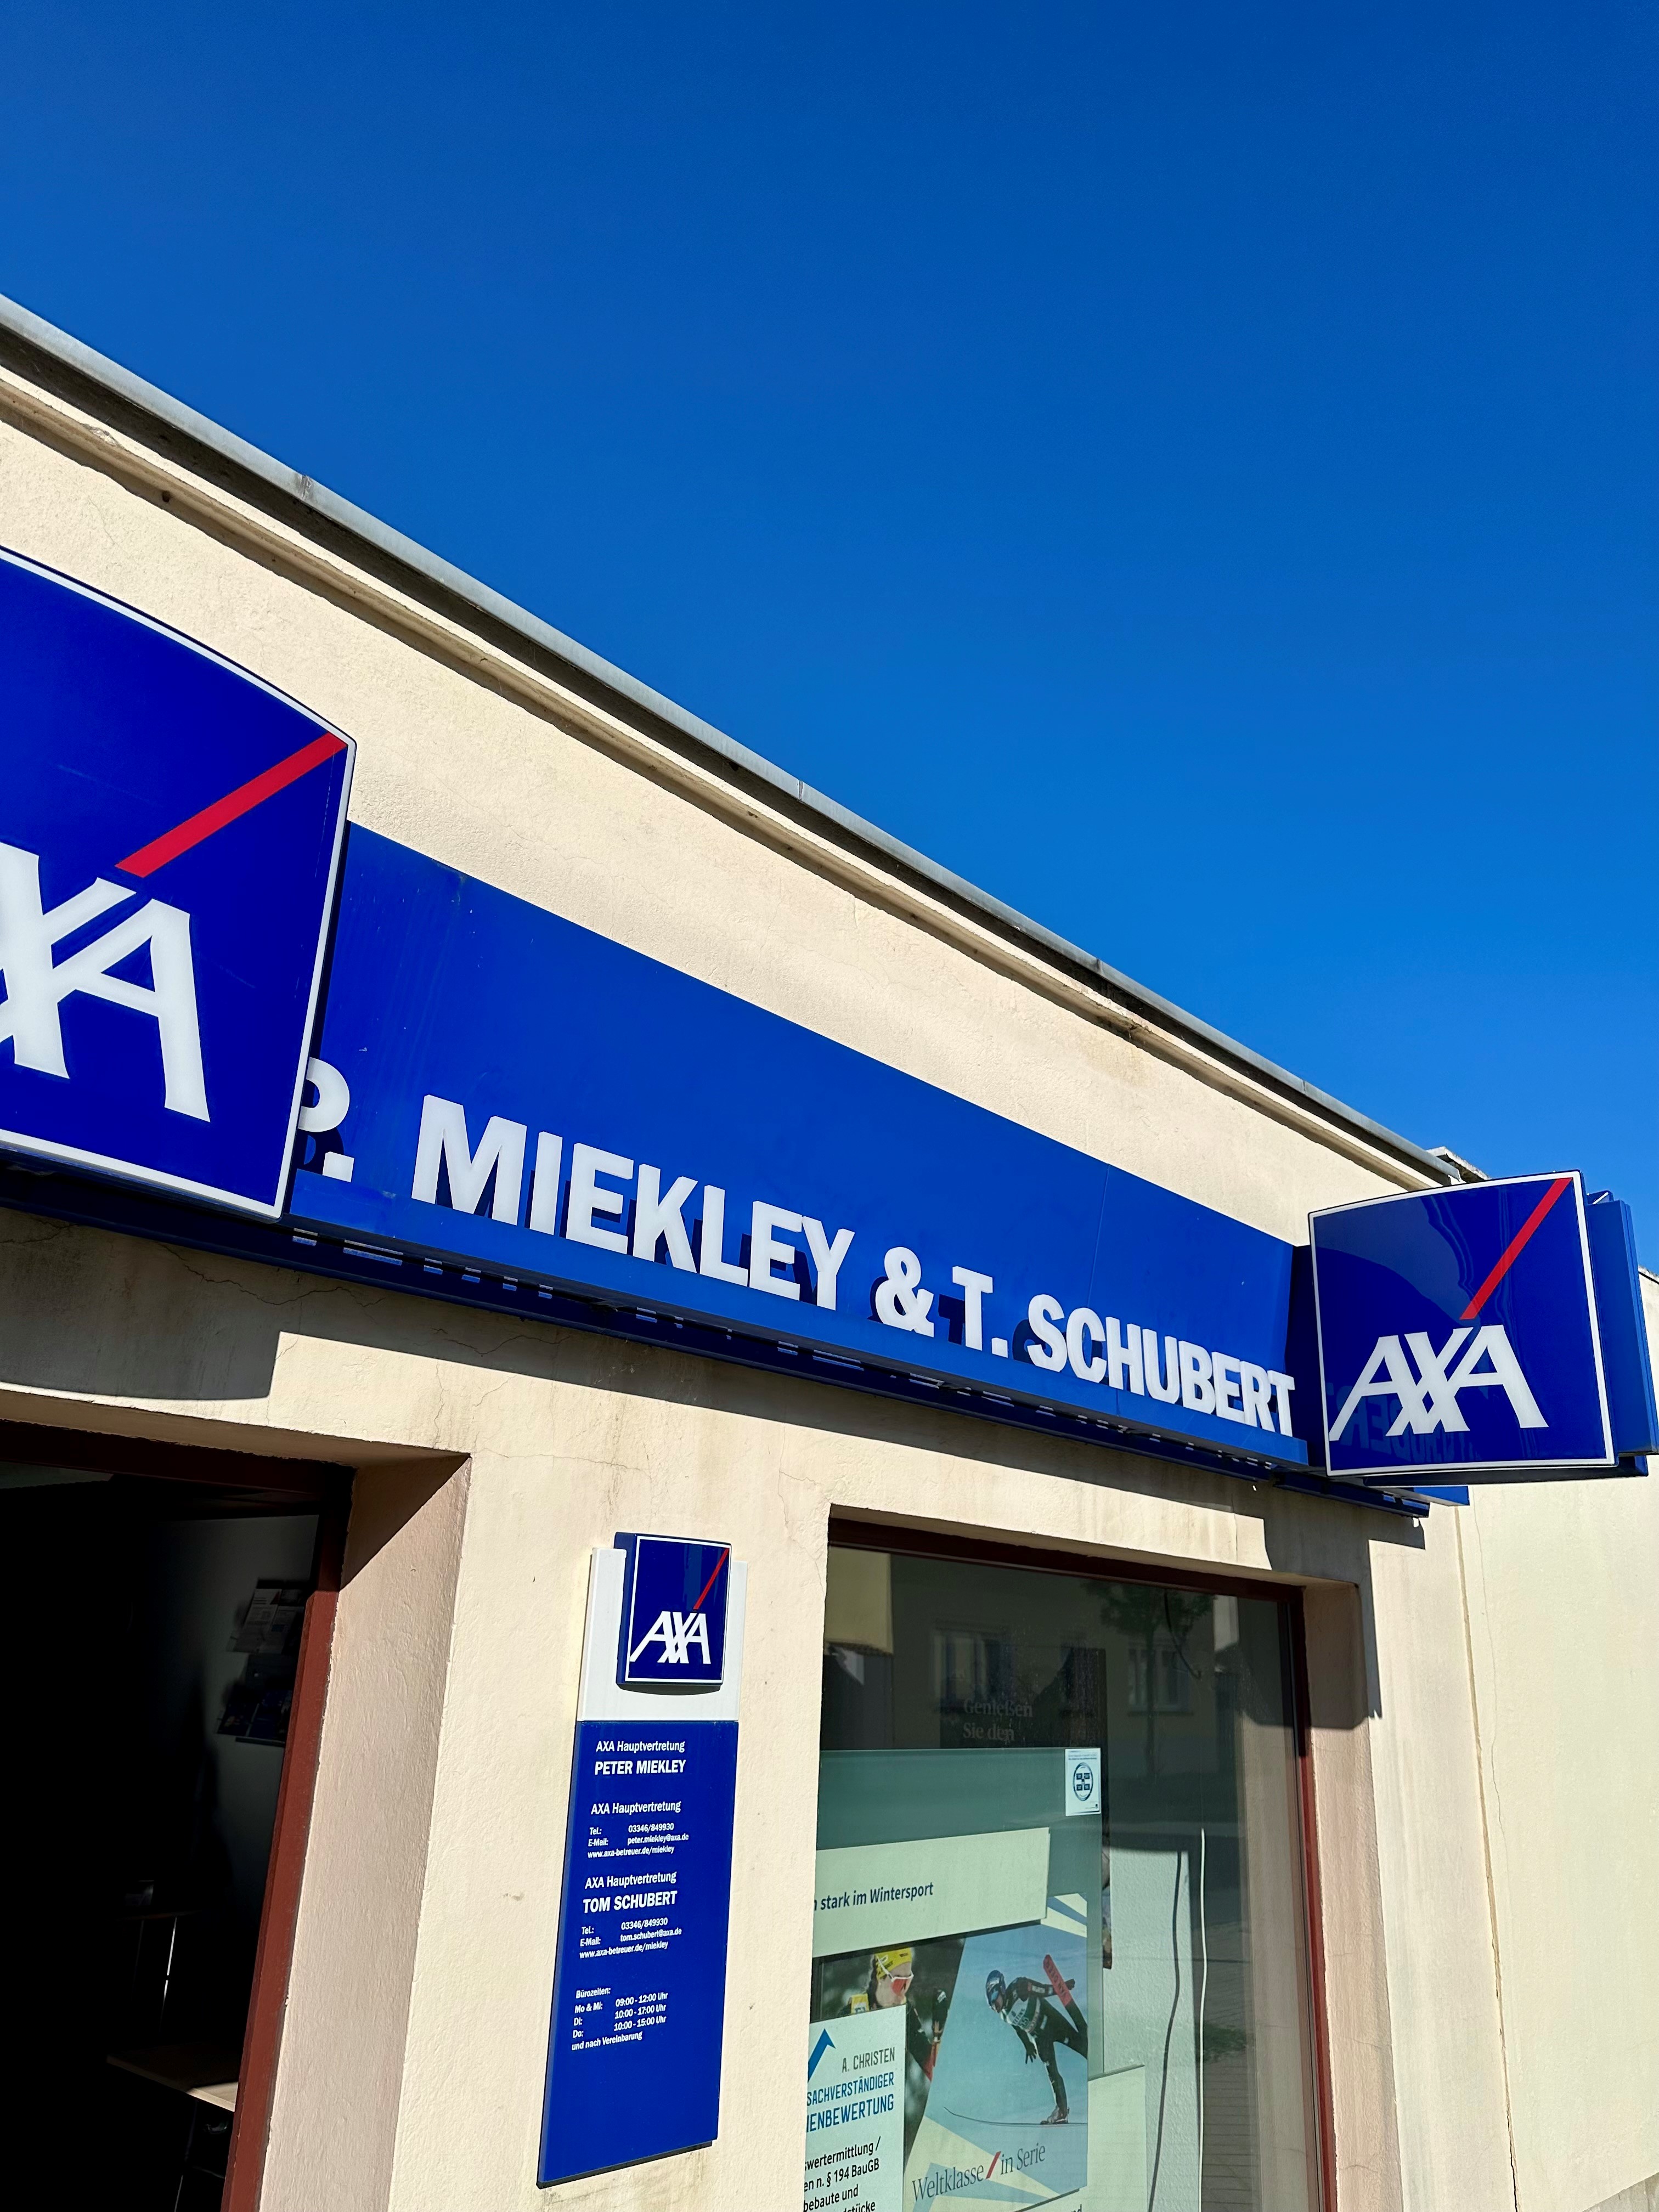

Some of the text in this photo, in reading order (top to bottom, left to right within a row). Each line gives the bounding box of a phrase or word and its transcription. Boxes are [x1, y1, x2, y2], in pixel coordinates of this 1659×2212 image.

[411, 1094, 855, 1311] MIEKLEY
[874, 1246, 934, 1338] &
[952, 1266, 1008, 1357] T.
[1026, 1294, 1295, 1437] SCHUBERT
[1329, 1324, 1549, 1441] AXA
[629, 1611, 711, 1664] AXA
[963, 1697, 1034, 1718] Genießen
[962, 1721, 1014, 1741] Sie den
[596, 1741, 685, 1753] AXA Hauptvertretung
[595, 1759, 686, 1775] PETER MIEKLEY
[591, 1801, 681, 1815] AXA Hauptvertretung
[589, 1822, 674, 1835] Tel.: 03346/849930
[588, 1833, 689, 1847] E-Mail: peter.miekley@axa.de
[588, 1845, 675, 1859] www.axa-betreuer.de/miekley
[585, 1871, 677, 1889] AXA Hauptvertretung
[583, 1891, 678, 1913] TOM SCHUBERT
[820, 1892, 850, 1910] stark
[853, 1890, 867, 1906] im
[870, 1882, 934, 1903] Wintersport
[580, 1927, 682, 1946] E-Mail: tom.schubert@axa.de
[581, 1917, 668, 1935] Tel.: 03346/849930
[579, 1940, 668, 1959] www.axa-betreuer.de/miekley
[574, 2005, 585, 2013] Mo
[586, 2004, 592, 2012] &
[592, 2001, 603, 2011] Mi:
[615, 1996, 634, 2007] 09:00
[638, 1993, 657, 2004] 12:00
[657, 1992, 668, 2000] Uhr
[575, 1987, 611, 1999] Bürozeiten:
[573, 2017, 583, 2026] Di:
[614, 2008, 633, 2019] 10:00
[637, 2005, 655, 2015] 17:00
[656, 2004, 667, 2012] Uhr
[572, 2030, 584, 2038] Do:
[613, 2020, 633, 2032] 10:00
[636, 2017, 655, 2028] 15:00
[656, 2015, 667, 2024] Uhr
[571, 2031, 643, 2051] und nach Vereinbarung
[842, 2047, 895, 2073] A. CHRISTEN
[807, 2072, 894, 2106] SACHVERSTÄNDIGER
[816, 2177, 824, 2188] n.
[826, 2172, 831, 2187] §
[834, 2166, 849, 2182] 194
[851, 2158, 879, 2177] BauGB
[912, 2165, 984, 2202] Weltklasse
[1000, 2154, 1013, 2175] in
[1016, 2143, 1046, 2170] Serie
[804, 2183, 859, 2212] bebaute und
